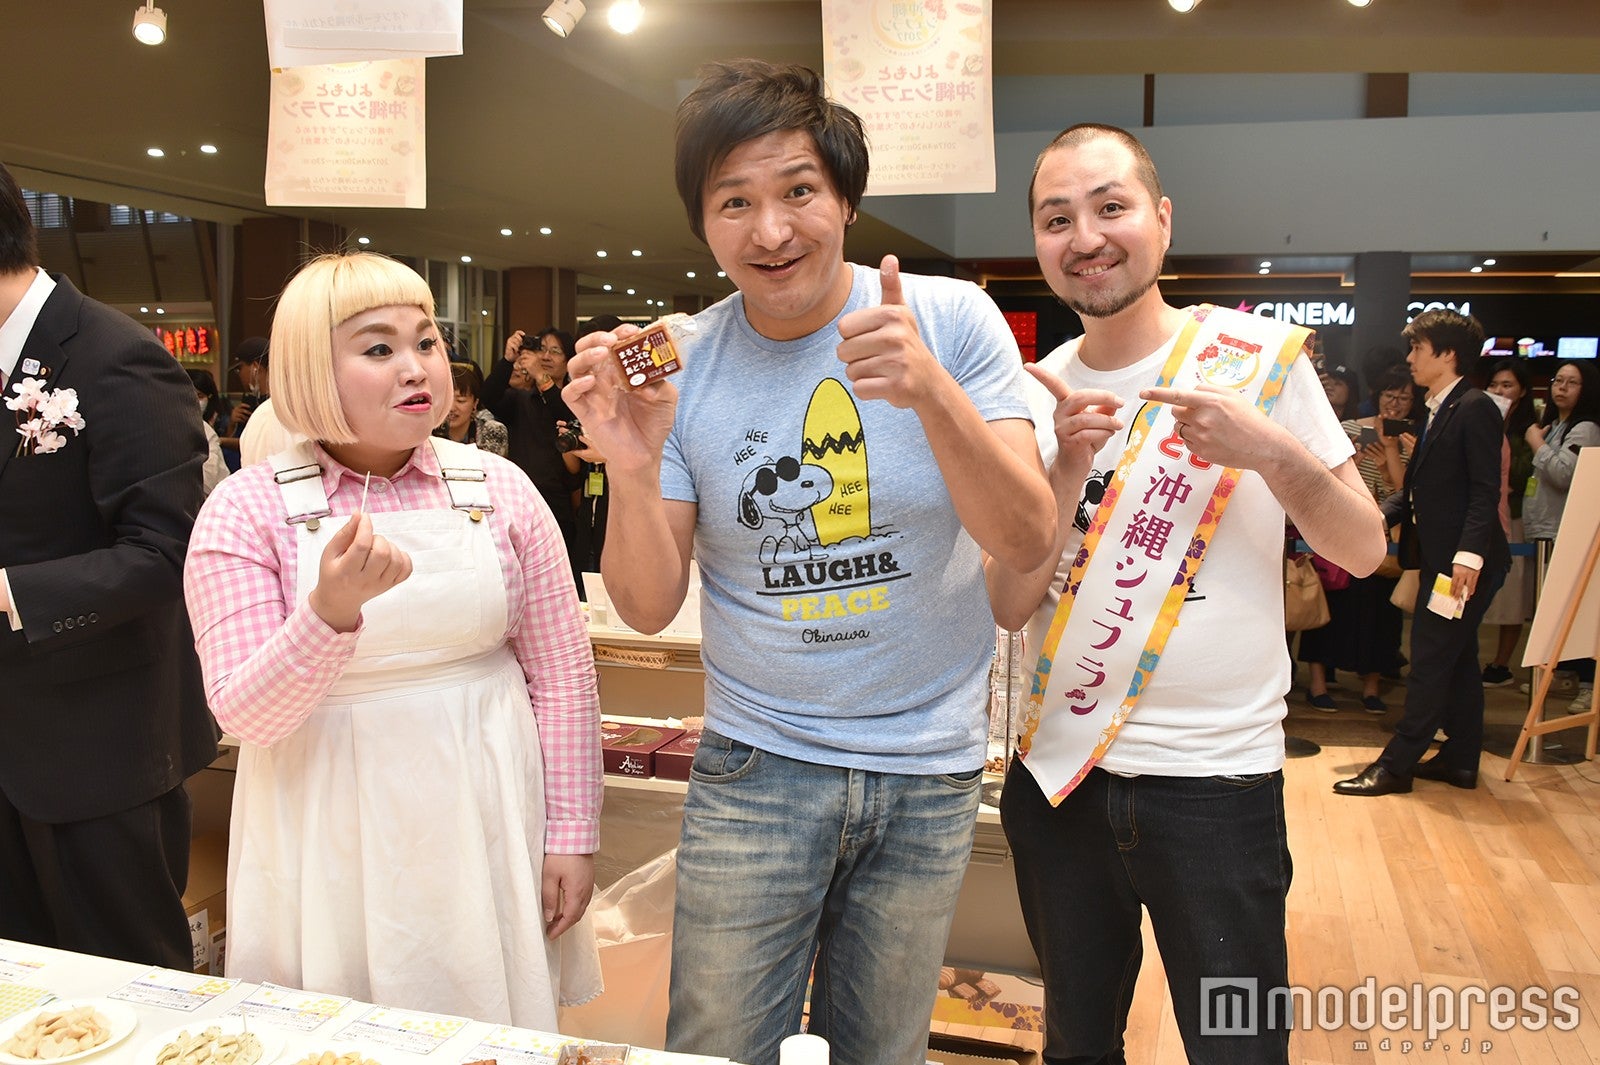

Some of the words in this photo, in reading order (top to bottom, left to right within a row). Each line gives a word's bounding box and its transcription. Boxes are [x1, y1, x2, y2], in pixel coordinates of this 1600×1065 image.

[619, 345, 640, 359] まるで
[621, 351, 650, 367] チーズな
[745, 429, 769, 444] HEE
[734, 445, 757, 466] HEE
[840, 480, 864, 498] HEE
[828, 503, 853, 515] HEE
[762, 551, 901, 589] LAUGH&
[1069, 465, 1193, 716] 沖縄シュフラン
[780, 585, 891, 622] PEACE
[801, 628, 872, 644] Okinawa
